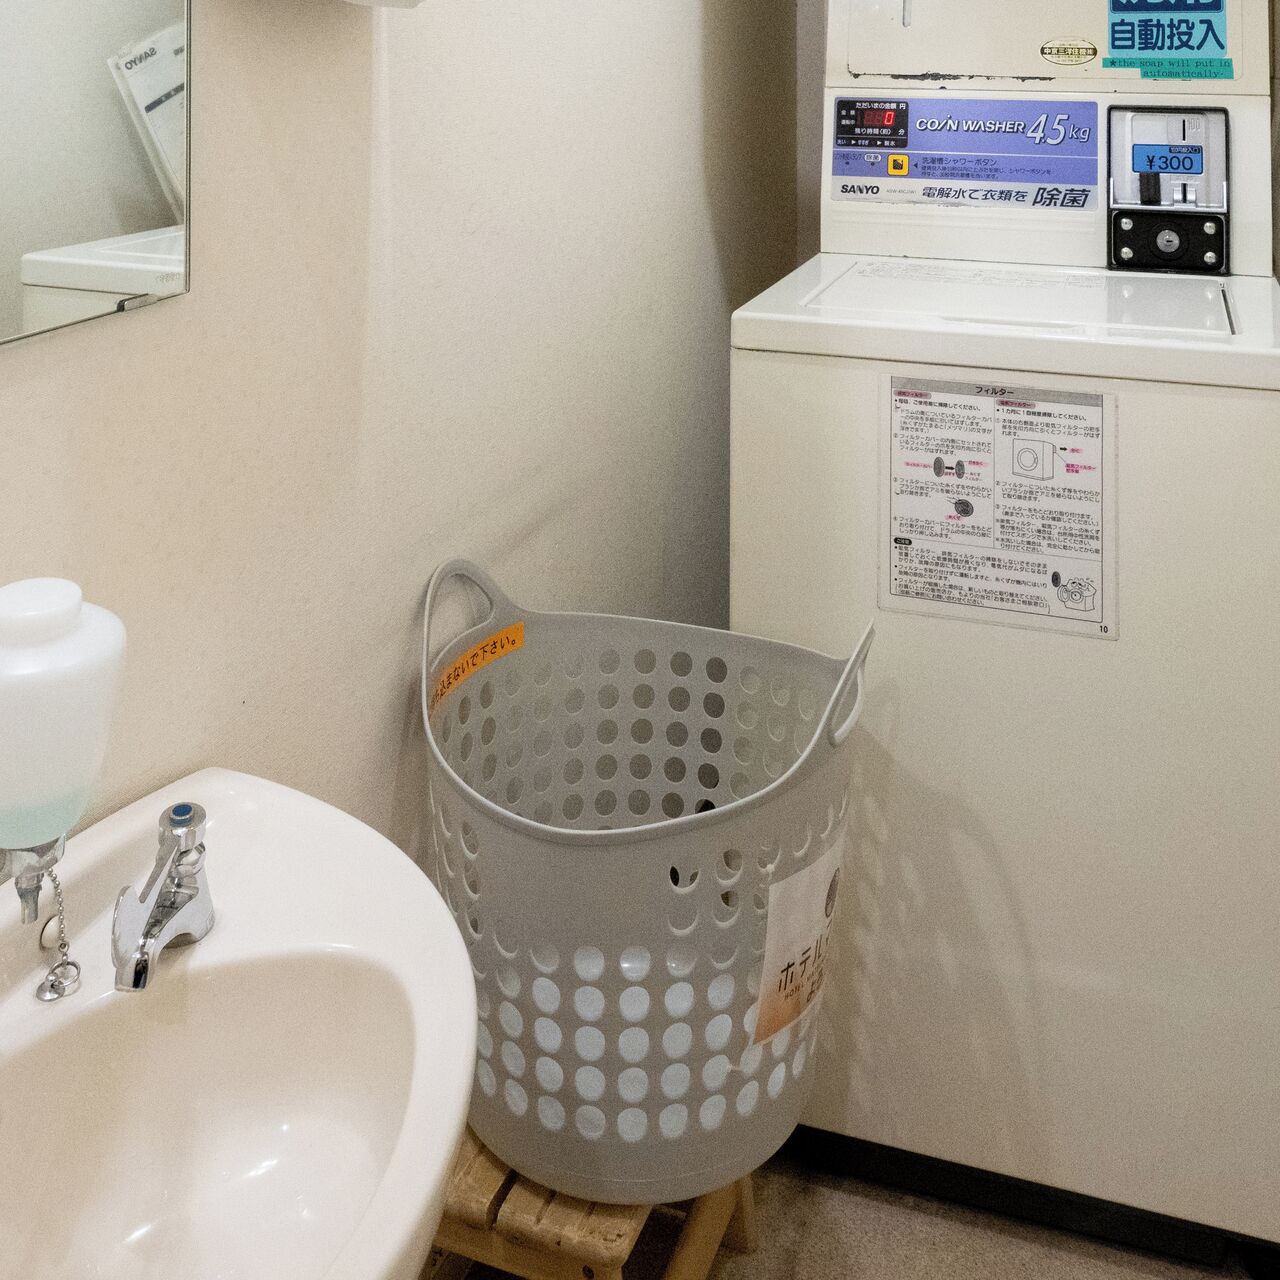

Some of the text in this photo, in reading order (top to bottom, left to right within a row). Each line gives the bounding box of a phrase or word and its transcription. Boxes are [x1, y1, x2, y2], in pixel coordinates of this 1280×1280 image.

[1111, 18, 1225, 51] 自動投入
[1117, 58, 1136, 67] the
[1139, 59, 1164, 69] soap
[1168, 58, 1193, 67] will
[1195, 59, 1215, 68] put
[856, 102, 897, 110] ただいまの金額
[884, 111, 895, 125] 0
[963, 120, 1027, 133] WASHER
[1069, 124, 1091, 142] kg
[1147, 155, 1194, 171] ¥300
[841, 184, 880, 195] SANYO
[922, 187, 1091, 208] 電解水で衣類を 除菌
[976, 386, 1014, 396] フィルター
[1100, 625, 1108, 633] 10
